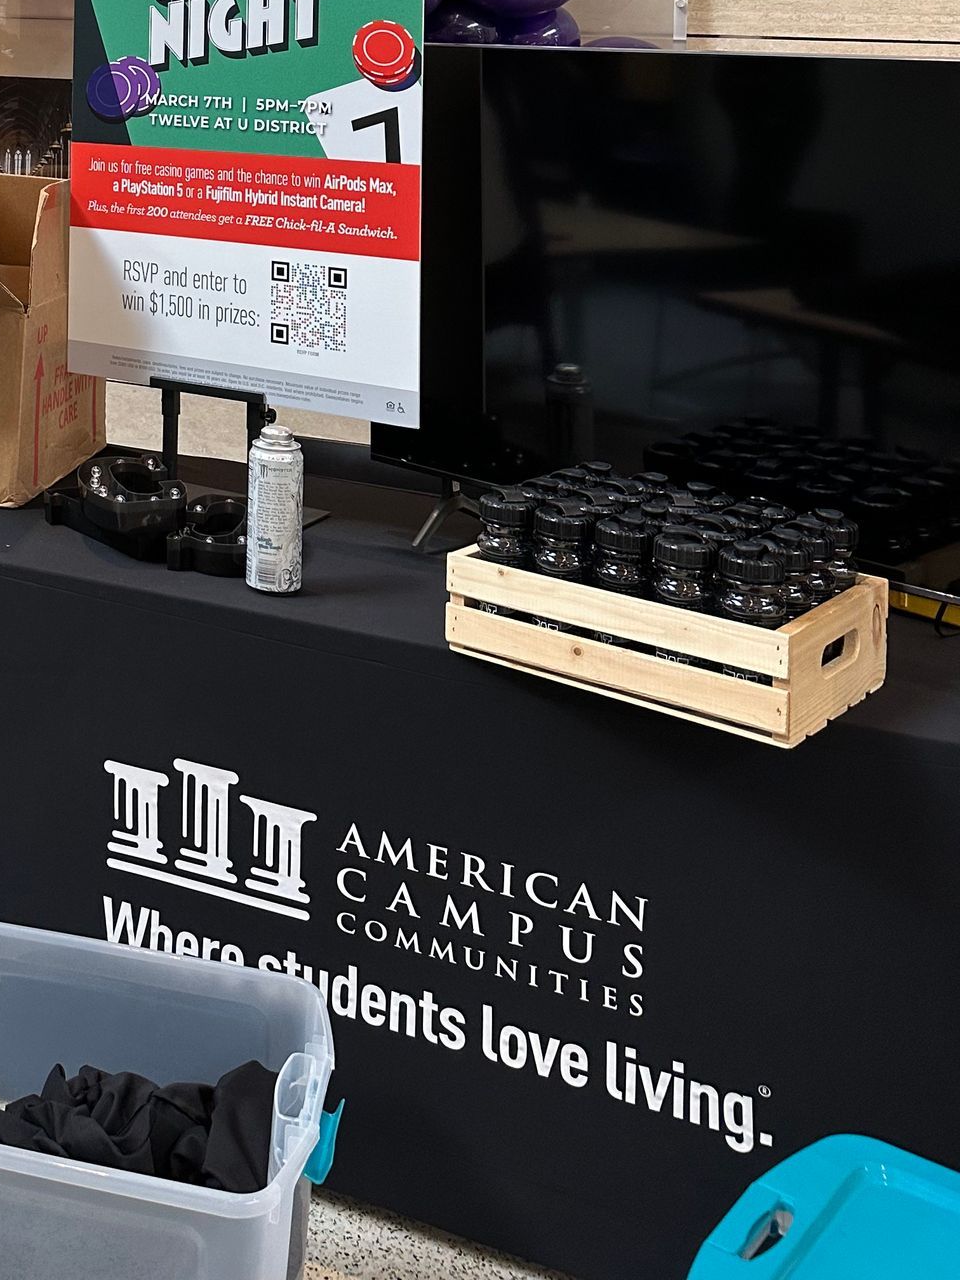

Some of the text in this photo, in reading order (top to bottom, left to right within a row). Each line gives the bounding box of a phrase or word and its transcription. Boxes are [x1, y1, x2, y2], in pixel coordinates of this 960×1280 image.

[146, 93, 199, 107] MARCH
[203, 96, 232, 109] 7TH
[149, 113, 327, 136] TWELVE AT U DISTRICT
[88, 158, 397, 197] Join us for free casino games and the chance to win AirPods Max,
[112, 178, 366, 213] a PlayStation 5 or a Fujifilm Hybrid Instant Camera!
[87, 200, 398, 240] Plus, the first 200 attendees get a FREE Chick-fil-A Sandwich.
[123, 259, 247, 295] RSVP and enter to
[122, 290, 260, 328] win $1,500 in prizes:
[37, 324, 48, 345] UP
[42, 381, 73, 417] HANDLE
[58, 401, 78, 429] CARE
[336, 822, 649, 933] AMERICAN
[336, 866, 645, 980] CAMPUS
[336, 912, 645, 1017] COMMUNITIES
[481, 1003, 588, 1089] love
